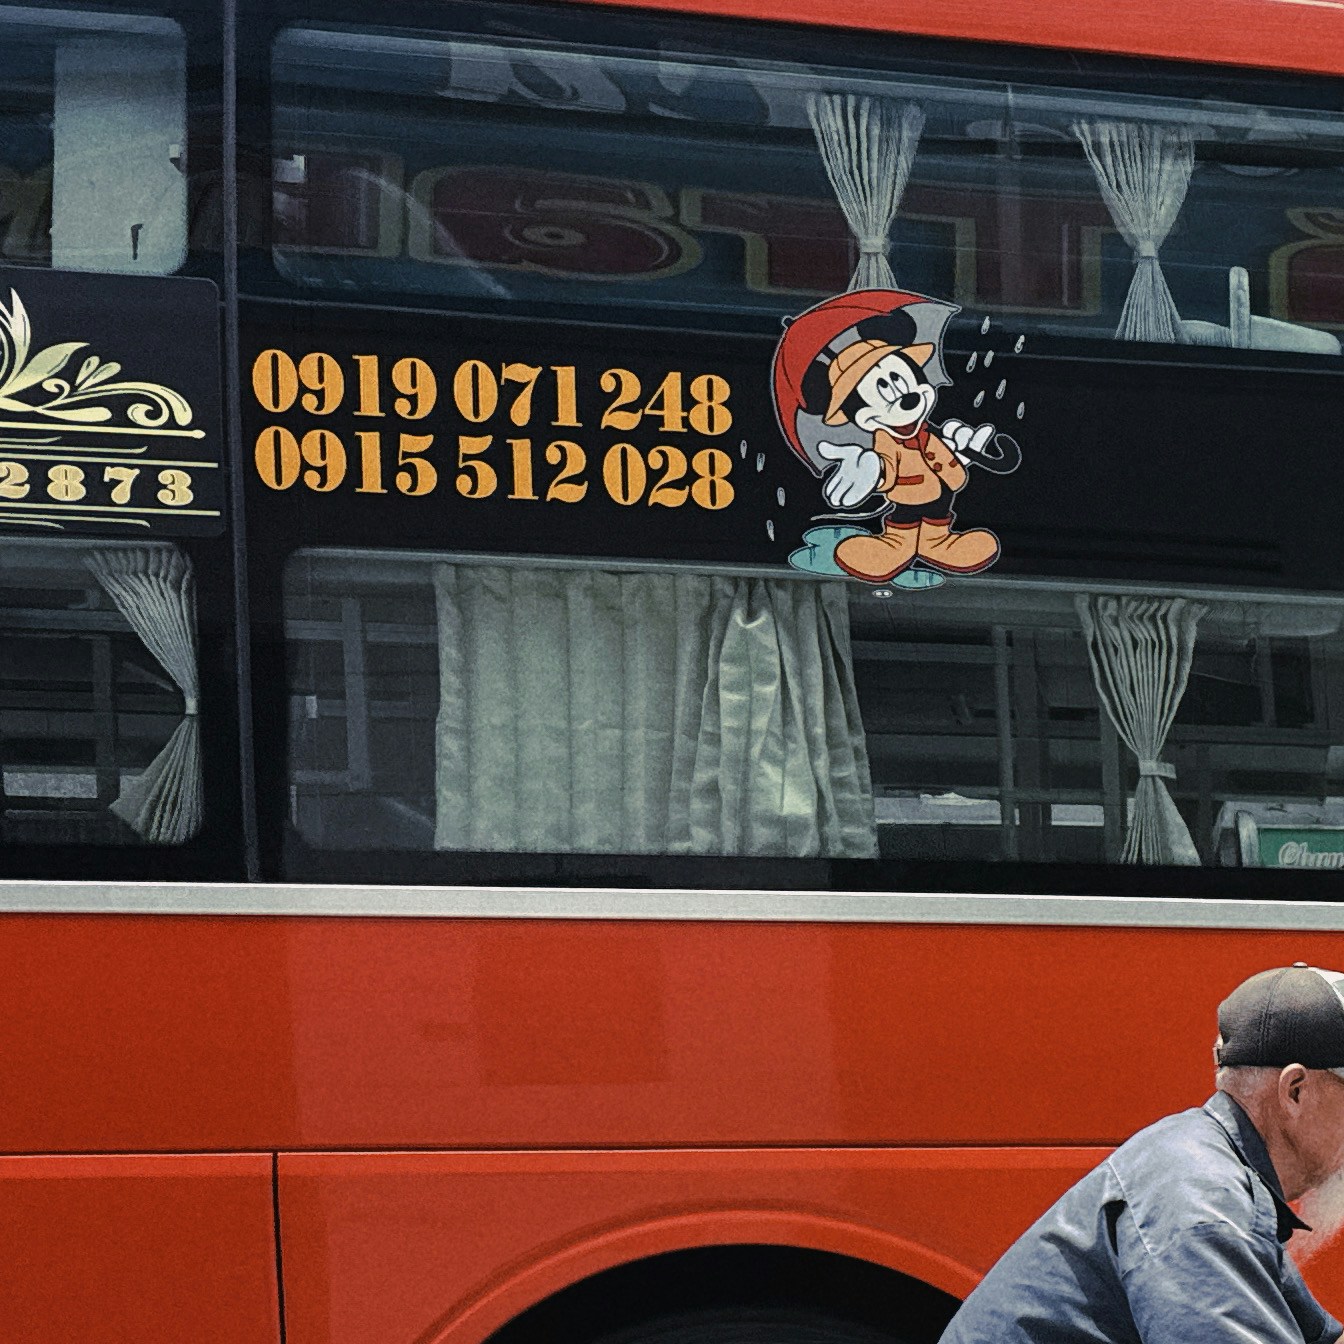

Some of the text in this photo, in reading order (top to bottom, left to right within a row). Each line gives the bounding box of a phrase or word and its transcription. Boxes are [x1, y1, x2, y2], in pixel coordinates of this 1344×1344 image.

[252, 349, 733, 435] 0919 071 248
[254, 426, 735, 510] 0915 512 028
